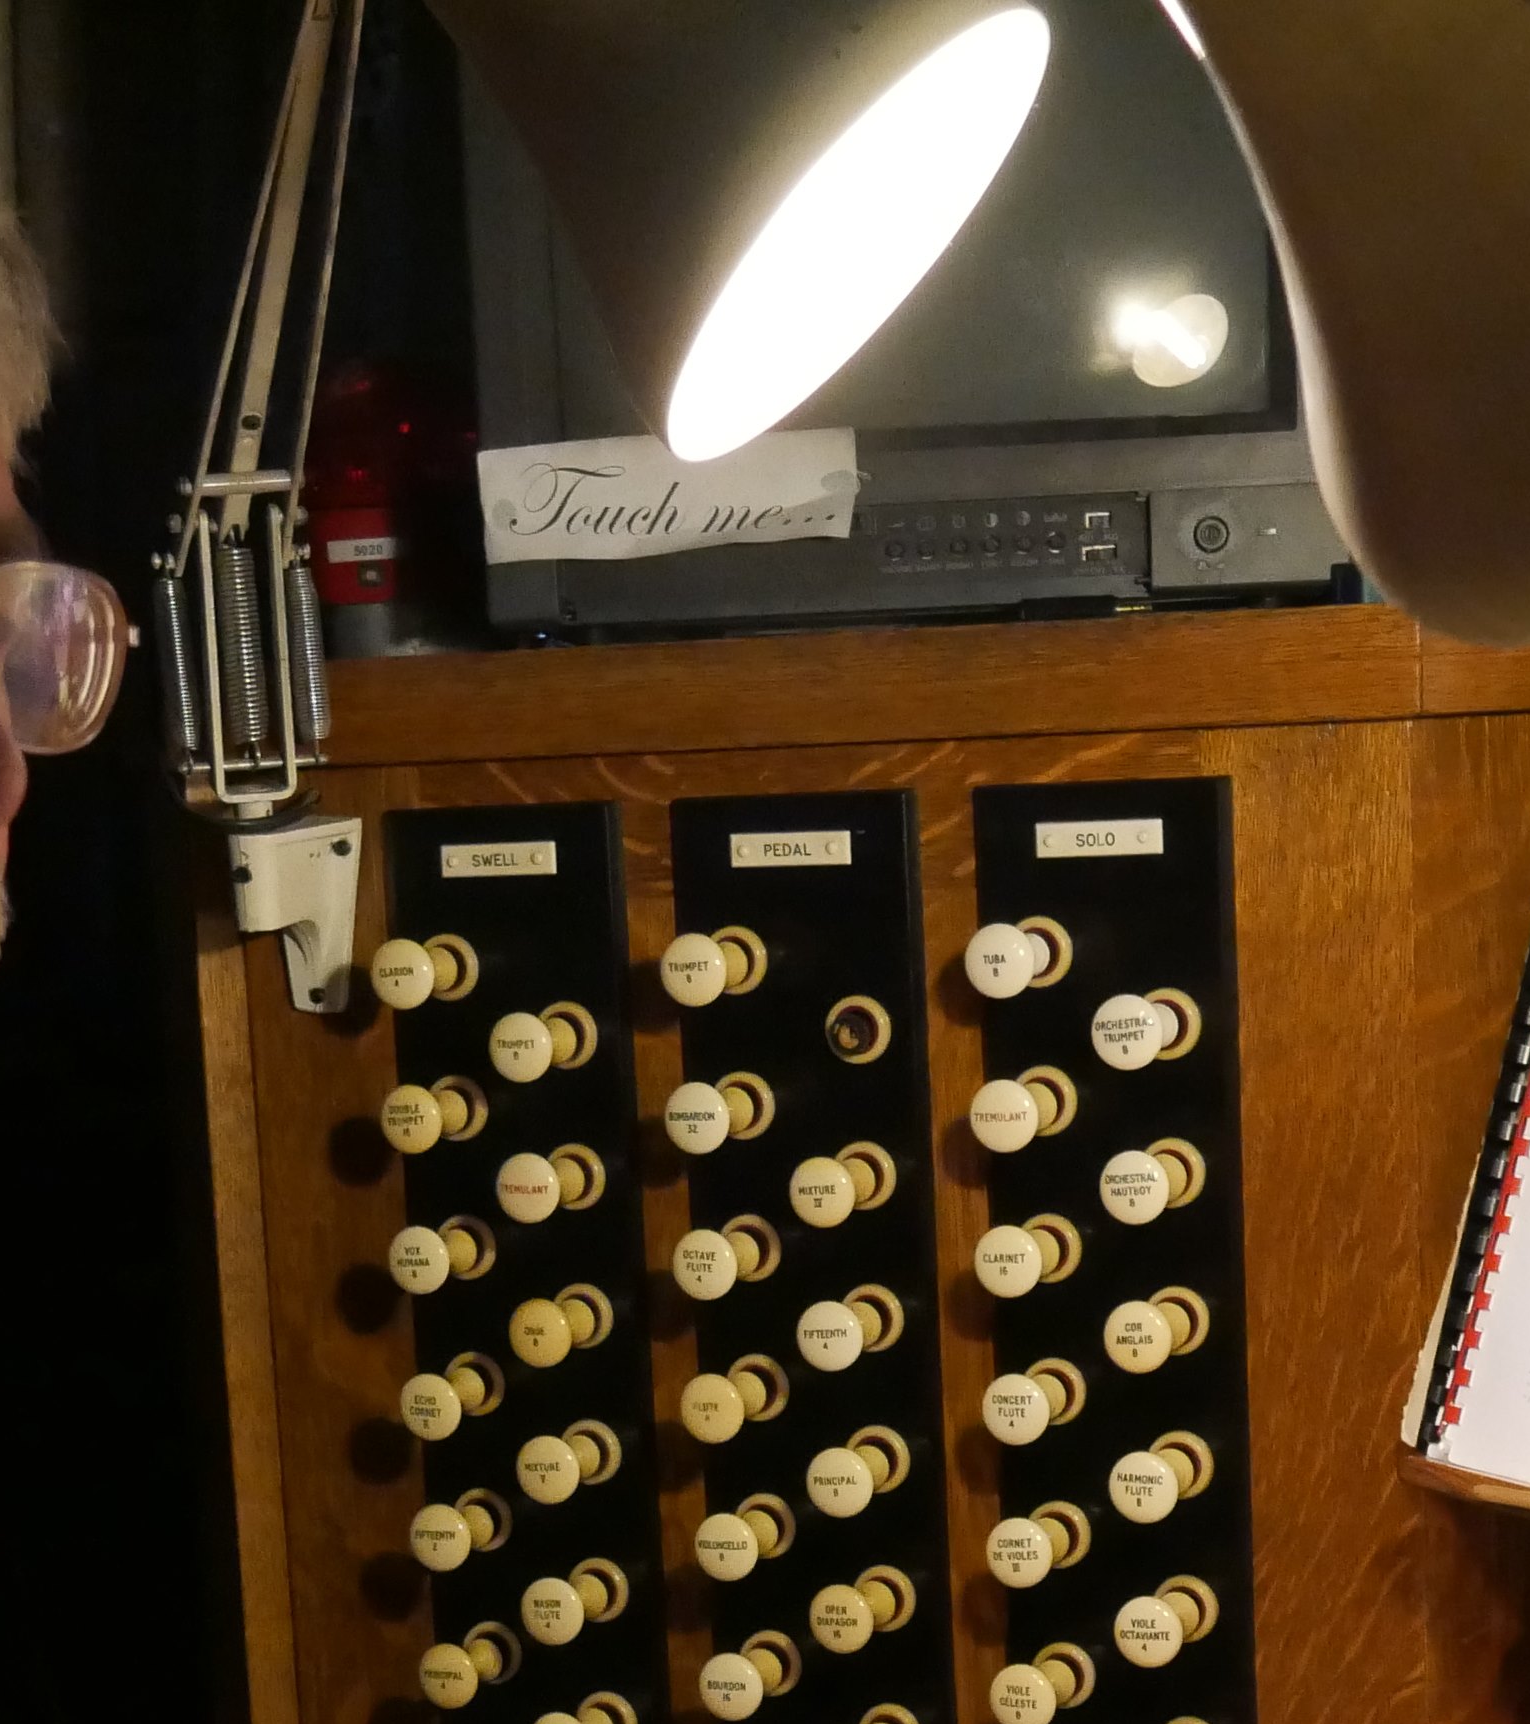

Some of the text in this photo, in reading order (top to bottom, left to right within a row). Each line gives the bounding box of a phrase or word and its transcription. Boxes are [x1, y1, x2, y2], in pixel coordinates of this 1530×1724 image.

[510, 462, 685, 535] Touch
[1075, 832, 1115, 848] SOLO
[762, 842, 812, 857] PEDAL
[471, 852, 518, 868] SWELL
[983, 953, 1007, 965] TUBA
[378, 966, 414, 979] CLARION
[669, 961, 709, 973] TRUMPET
[1103, 1030, 1145, 1044] TRUMPET
[497, 1040, 535, 1051] TRUMPET
[973, 1112, 1028, 1124] TREMULANT
[1105, 1173, 1157, 1185] ORCHESTRAL
[798, 1185, 836, 1196] MIXTURE
[1110, 1186, 1152, 1197] HAUTBOY
[683, 1250, 717, 1262] OCTAVE
[982, 1253, 1025, 1265] CLARINET
[686, 1262, 713, 1274] FLUTE
[999, 1265, 1009, 1277] 16
[1125, 1322, 1142, 1333] COR
[803, 1328, 847, 1340] FIFTEENTH
[1116, 1335, 1153, 1346] ANGLAIS
[991, 1395, 1032, 1407] CONCERT
[998, 1407, 1026, 1419] FLUTE
[813, 1475, 857, 1487] PRINCIPAL
[1116, 1472, 1164, 1486] HARMONIC
[1125, 1486, 1153, 1498] FLUTE
[997, 1538, 1031, 1549] CORNET
[992, 1550, 1039, 1562] DE VIOLES
[825, 1605, 847, 1616] OPEN
[816, 1616, 858, 1628] DIAPASON
[1130, 1618, 1156, 1630] VIOLE
[833, 1628, 842, 1639] 16
[1119, 1629, 1171, 1641] OCTAVIANTE
[1140, 1642, 1148, 1653] 4
[706, 1681, 747, 1693] BOURDON
[1006, 1684, 1031, 1696] VIOLE
